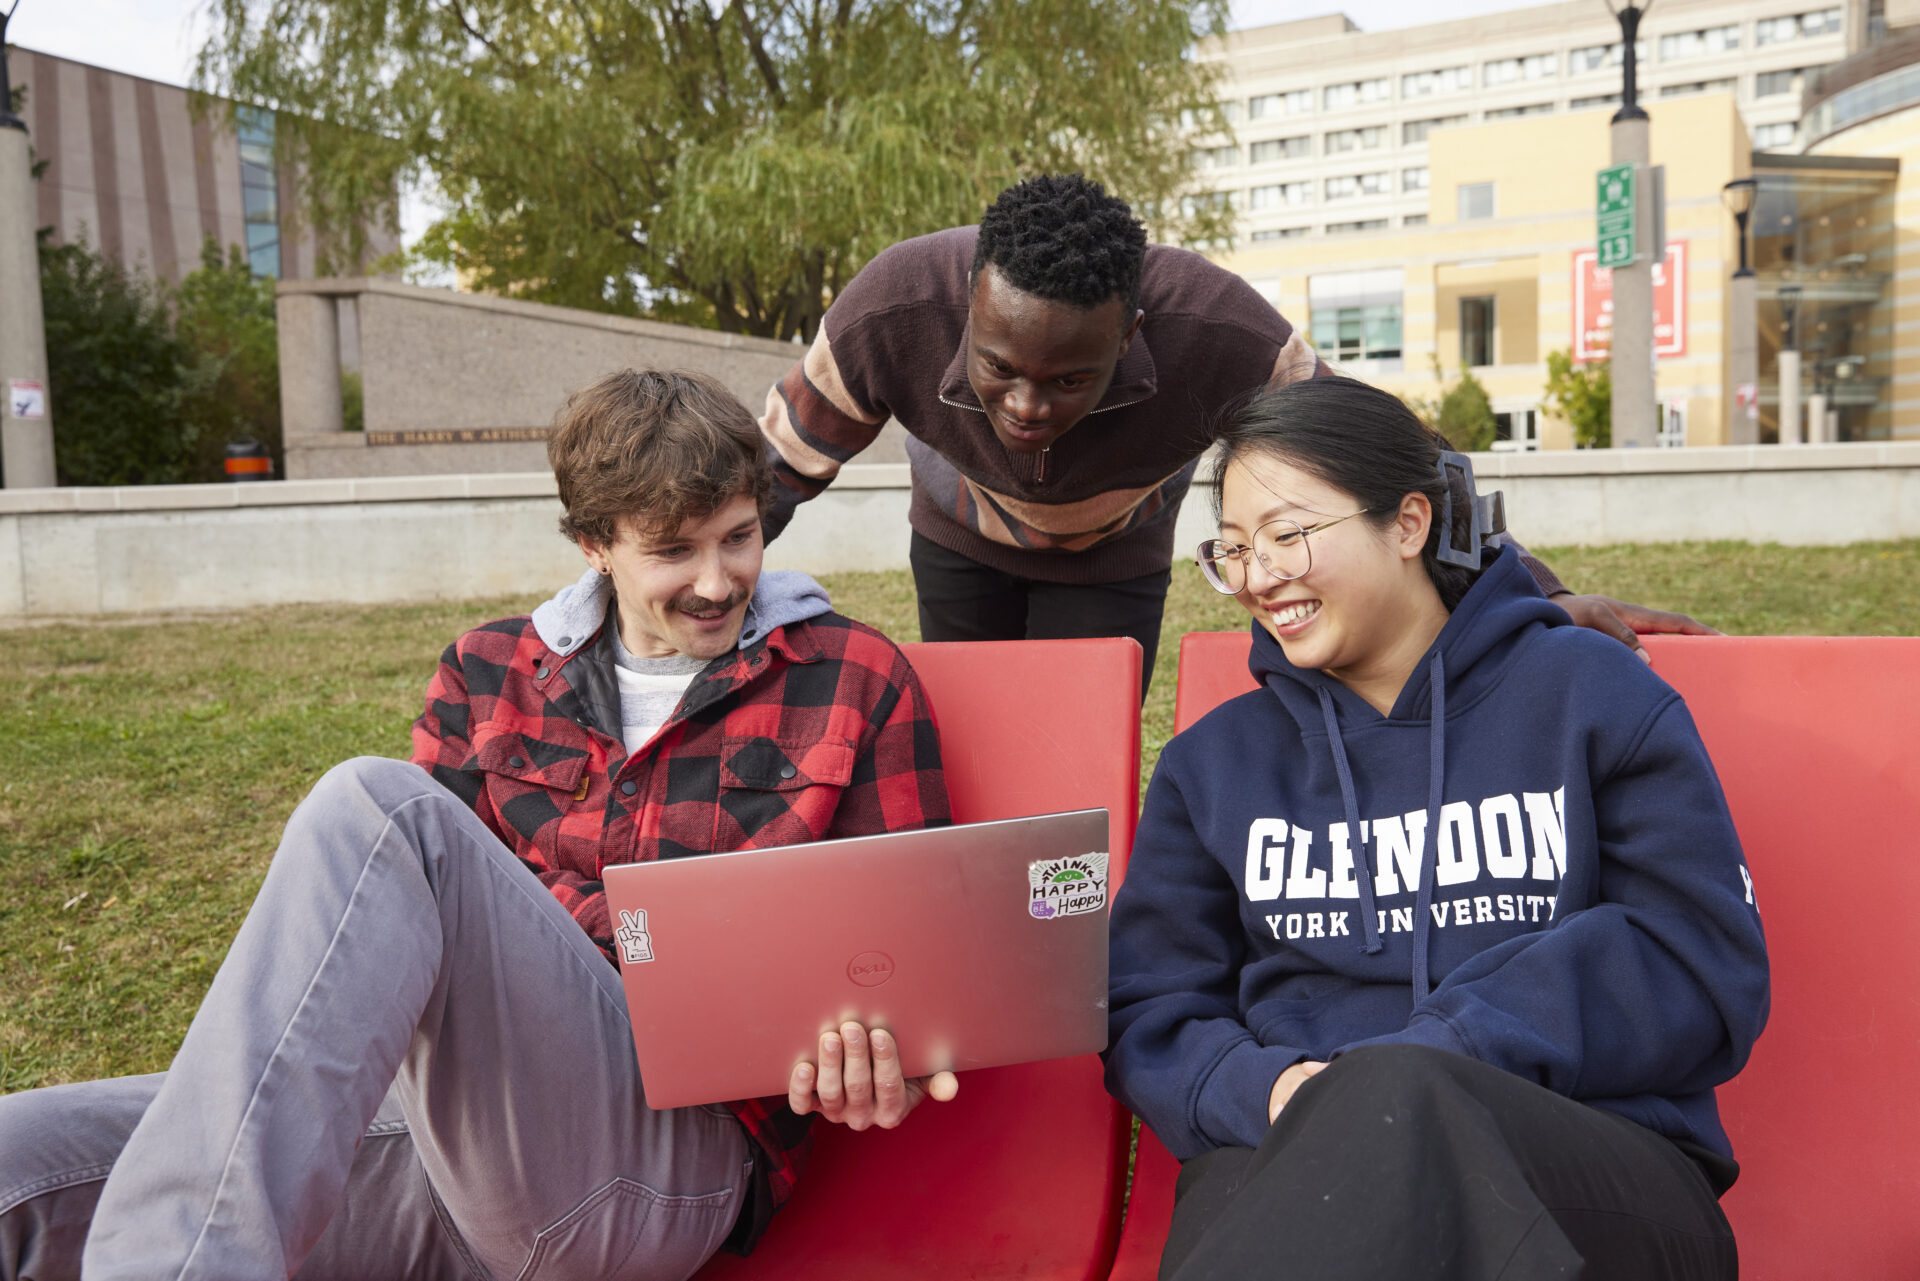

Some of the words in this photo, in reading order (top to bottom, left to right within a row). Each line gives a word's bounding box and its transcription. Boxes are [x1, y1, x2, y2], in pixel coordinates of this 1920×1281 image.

[1602, 238, 1629, 261] 13
[1245, 784, 1567, 902] GLENDON
[1042, 859, 1092, 877] THINK
[1032, 879, 1104, 899] HAPPY
[1057, 893, 1104, 915] Happy
[1265, 911, 1350, 940] YORK
[1377, 894, 1559, 934] NVERSITY
[853, 962, 889, 975] DELL
